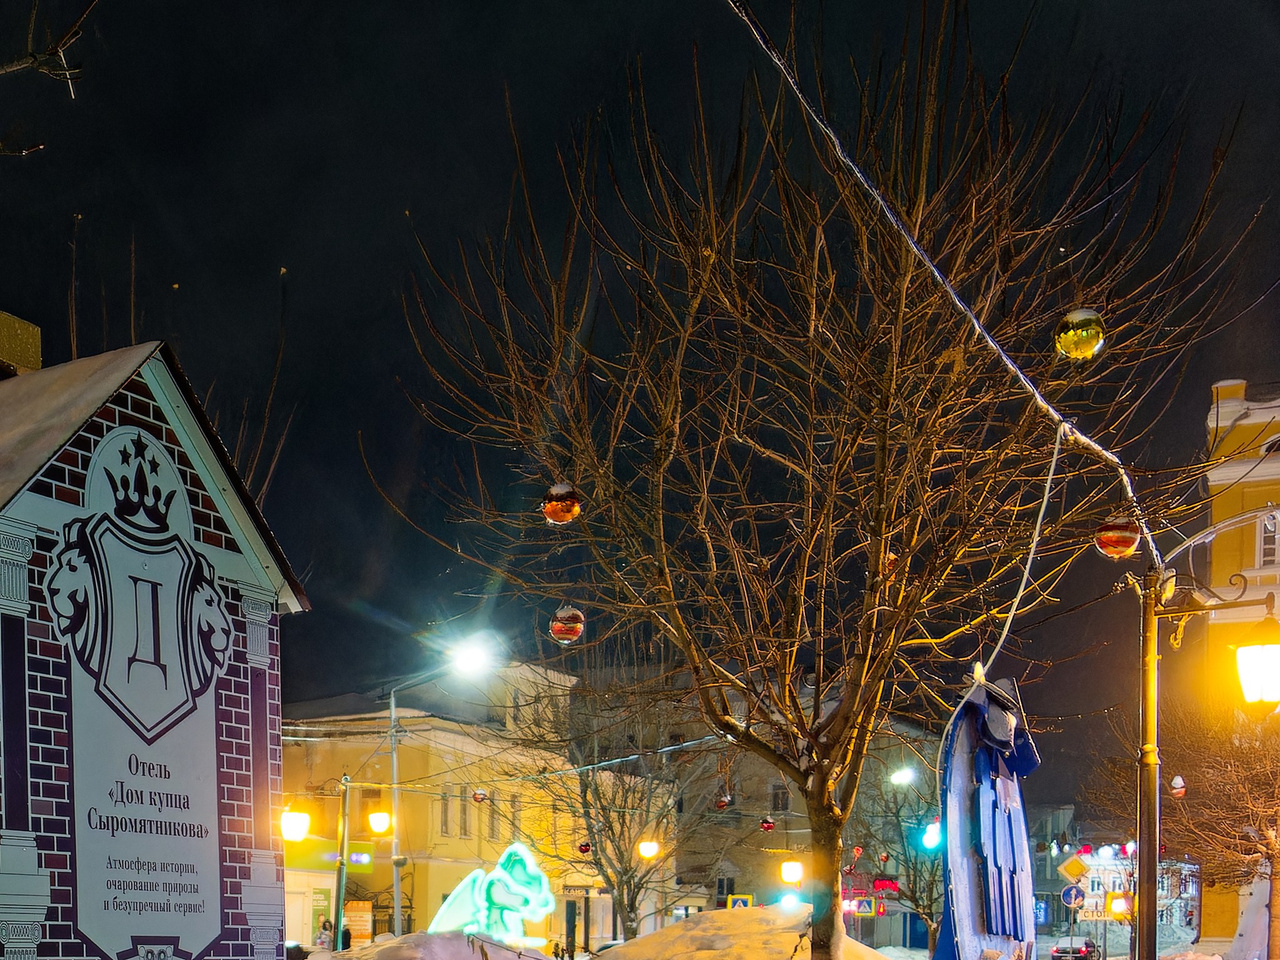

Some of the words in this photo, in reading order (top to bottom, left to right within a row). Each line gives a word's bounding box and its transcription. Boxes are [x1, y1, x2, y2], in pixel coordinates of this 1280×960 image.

[128, 575, 168, 690] Д
[128, 753, 171, 779] Отель
[108, 780, 144, 808] «Дом
[149, 790, 190, 813] купца
[87, 806, 210, 839] Сыромятникова»
[106, 855, 157, 875] Атмосфера
[160, 861, 198, 877] истории,
[106, 879, 160, 894] очарование
[162, 880, 199, 896] природы
[103, 899, 110, 911] и
[112, 896, 172, 916] безупречный
[173, 899, 206, 917] сервис!
